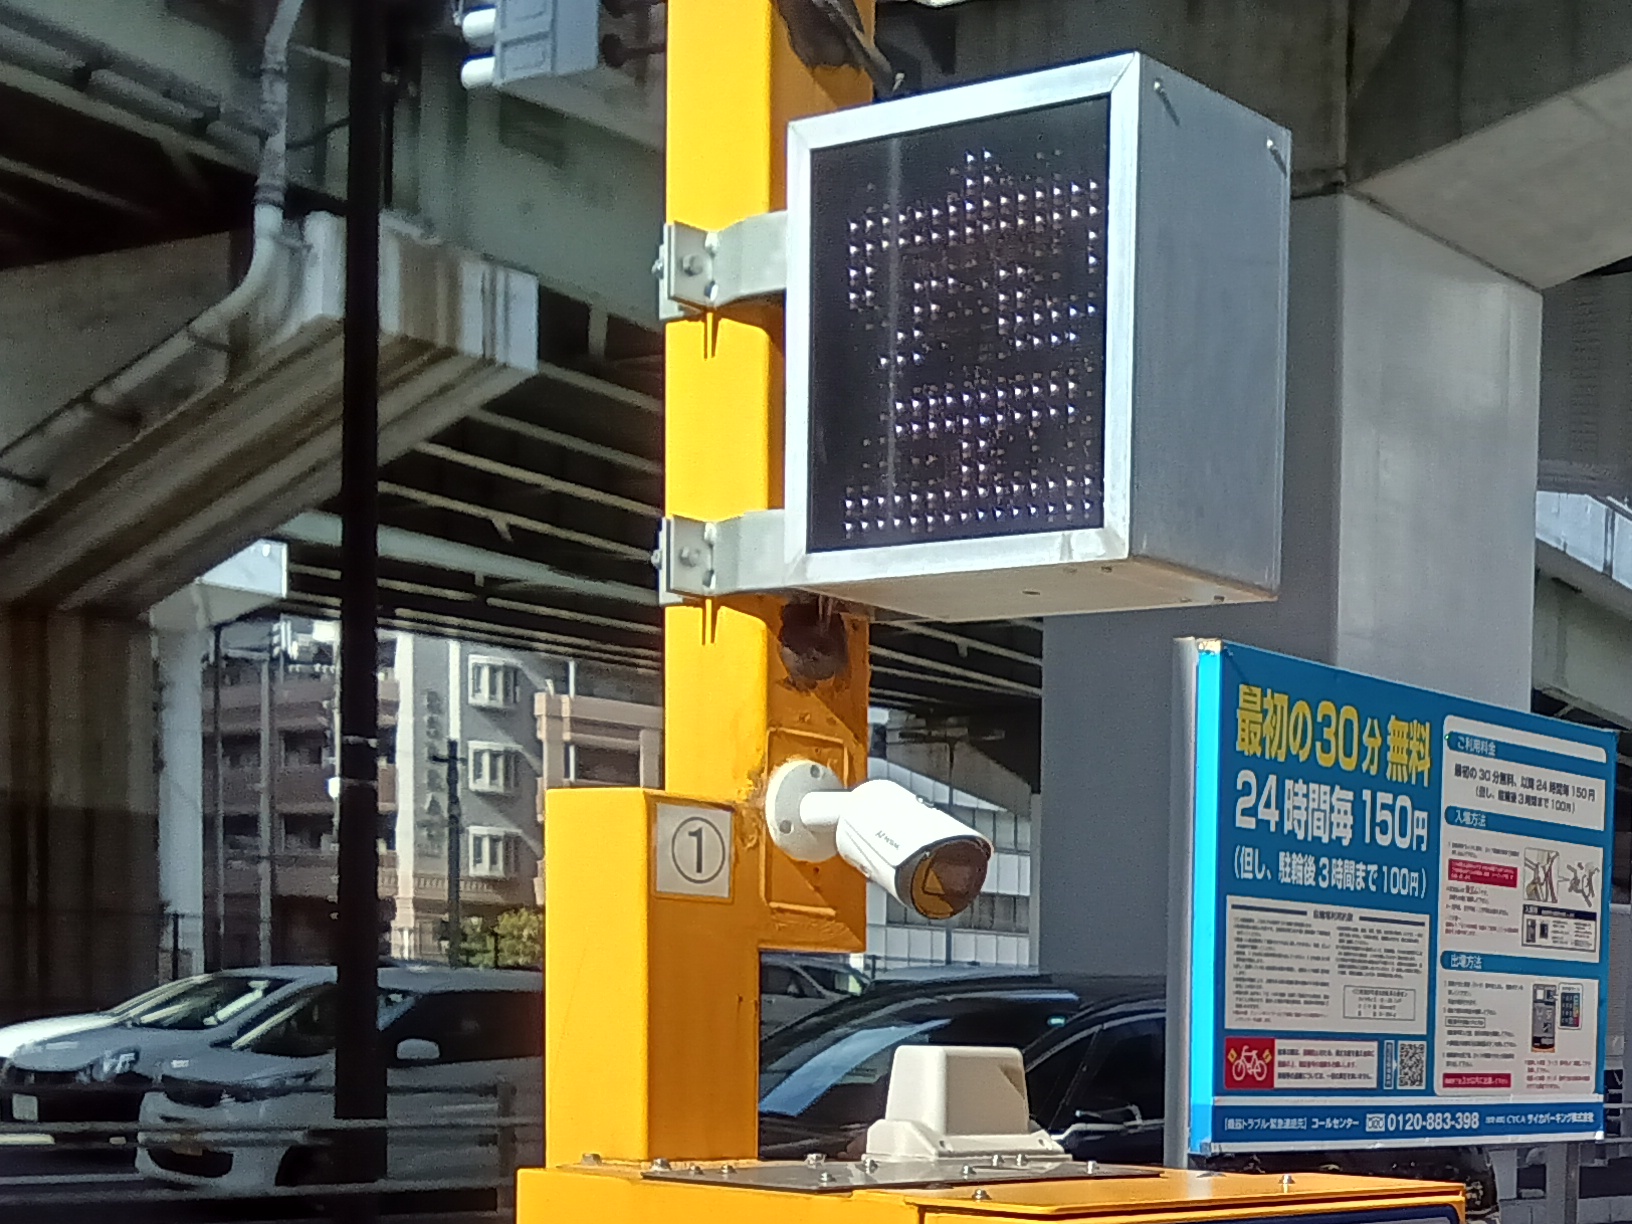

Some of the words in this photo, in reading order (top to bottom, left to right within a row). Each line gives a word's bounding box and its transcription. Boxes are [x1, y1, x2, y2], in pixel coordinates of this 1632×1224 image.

[1311, 1117, 1359, 1129] コールセンター
[1387, 1112, 1480, 1131] 0120-883-398
